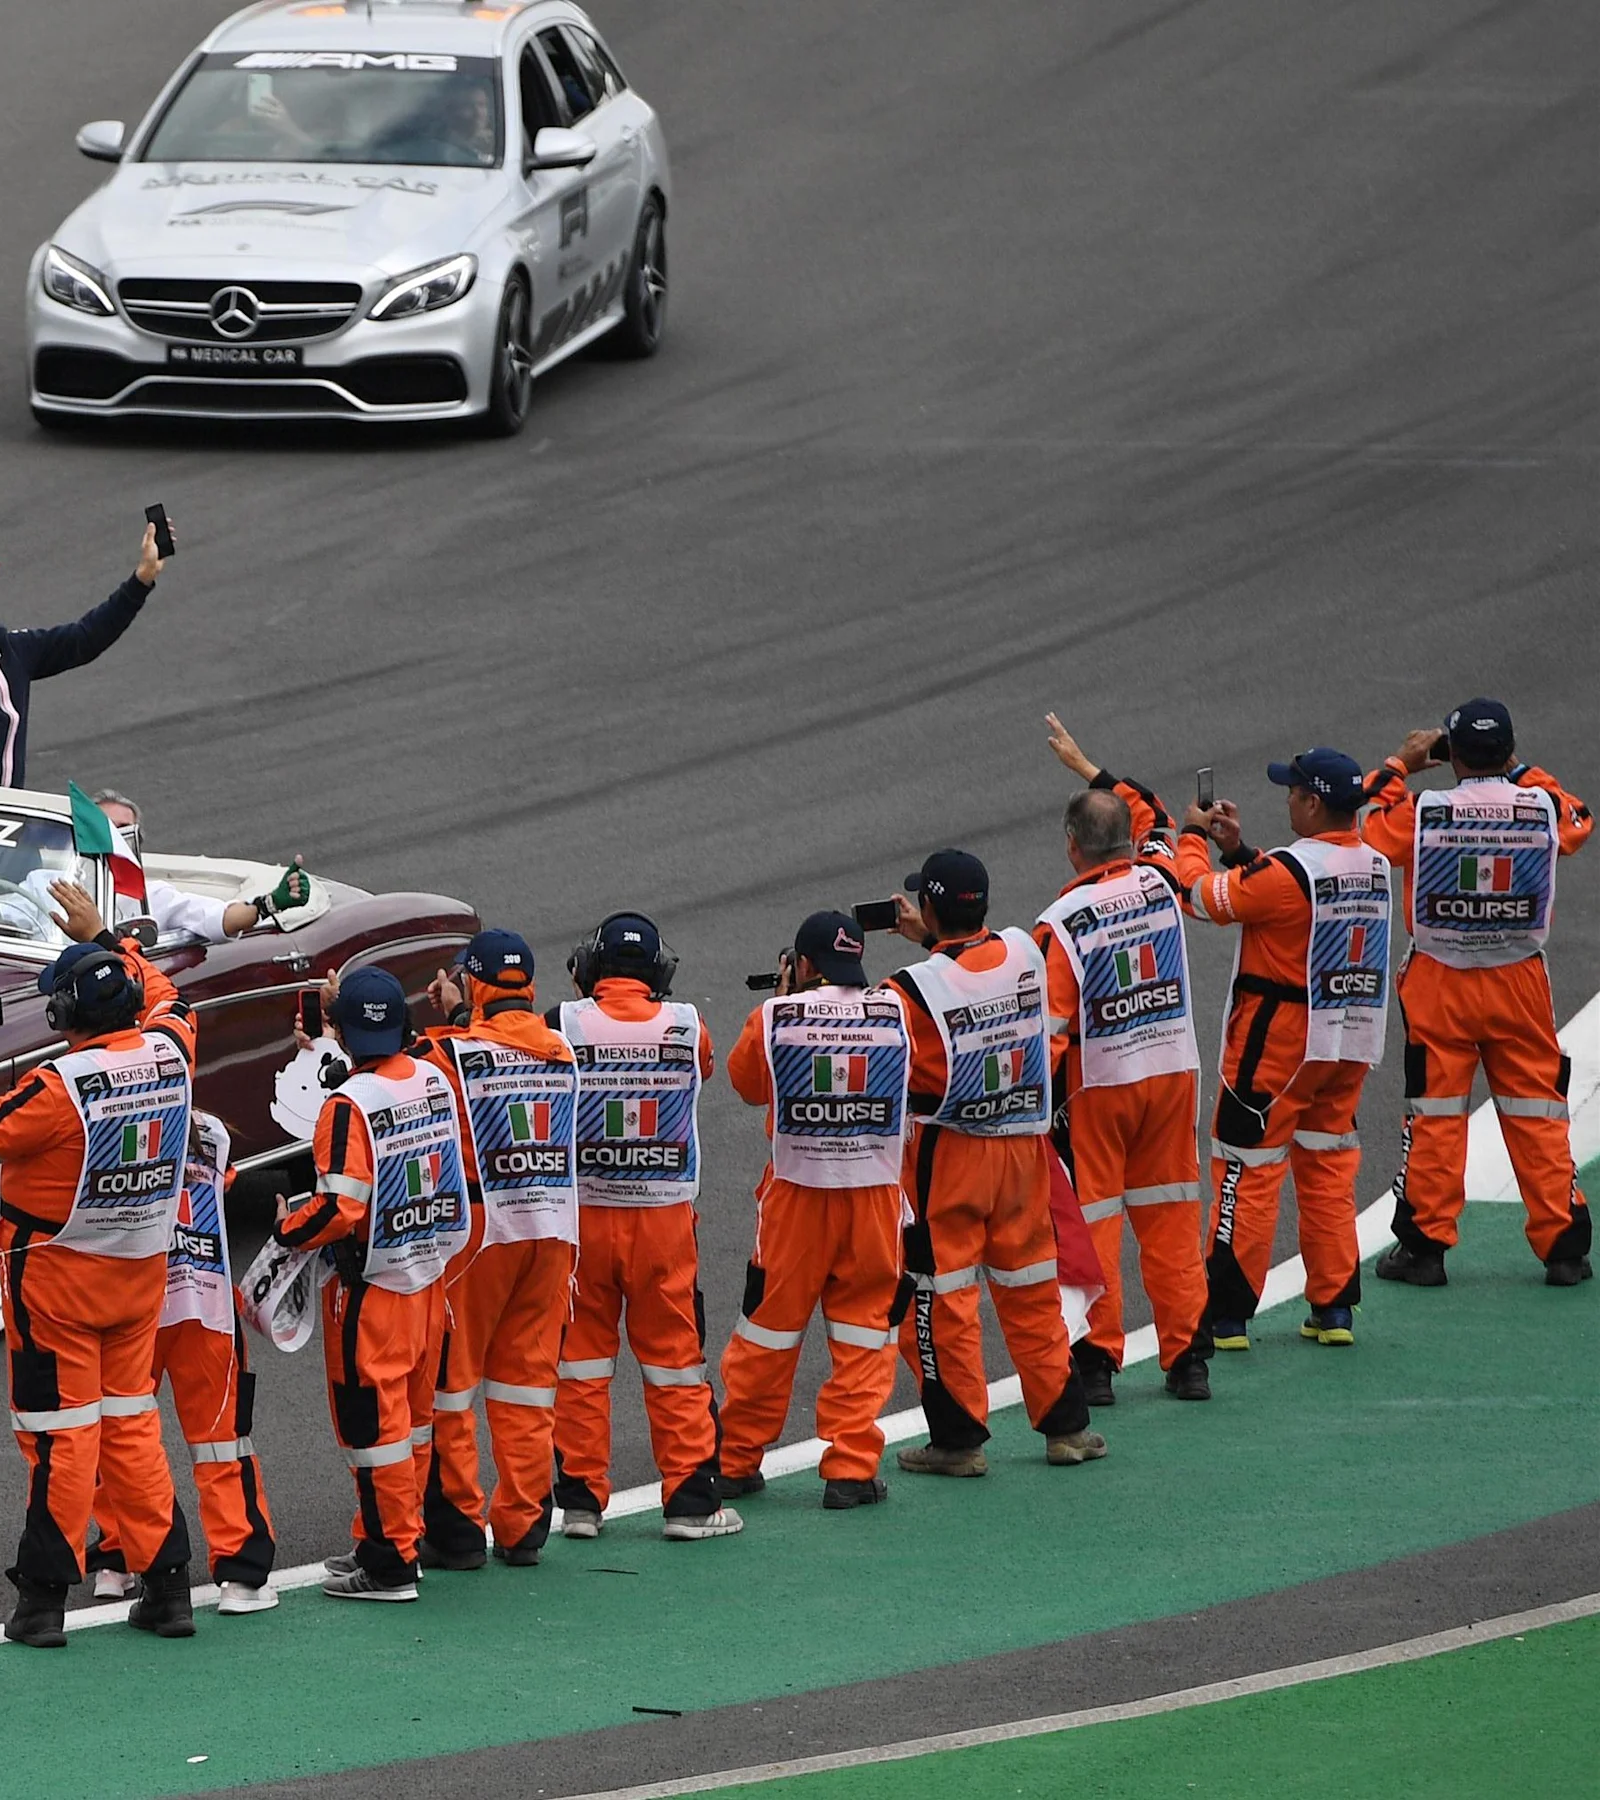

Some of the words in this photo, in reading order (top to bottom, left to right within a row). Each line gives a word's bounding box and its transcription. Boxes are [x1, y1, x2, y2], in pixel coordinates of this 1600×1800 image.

[300, 52, 457, 72] AMG
[191, 347, 260, 362] MEDICAL
[263, 348, 297, 363] CAR
[1455, 807, 1510, 819] MEX1293
[1435, 899, 1530, 920] COURSE
[807, 1004, 860, 1016] MEX1127
[973, 999, 1017, 1020] MEX1360
[1101, 984, 1180, 1021] COURSE
[807, 1032, 820, 1041] CH.
[821, 1033, 839, 1041] POST
[841, 1033, 874, 1041] MARSHAL
[994, 1029, 1019, 1040] MARSHAL
[598, 1047, 656, 1060] MEX1540
[111, 1067, 156, 1085] MEX1536
[482, 1081, 518, 1092] SPECTATOR
[519, 1080, 544, 1088] CONTROL
[620, 1077, 652, 1086] CONTROL
[102, 1101, 134, 1114] SPECTATOR
[135, 1096, 157, 1109] CONTROL
[158, 1092, 180, 1104] MARSHAL
[395, 1101, 429, 1121] MEX1549
[790, 1102, 886, 1123] COURSE
[960, 1089, 1039, 1119] COURSE
[386, 1137, 414, 1152] SPECTATOR
[494, 1151, 566, 1173] COURSE
[580, 1146, 680, 1167] COURSE
[97, 1165, 173, 1194] COURSE
[1216, 1160, 1243, 1245] MARSHAL
[916, 1290, 938, 1381] MARSHAL
